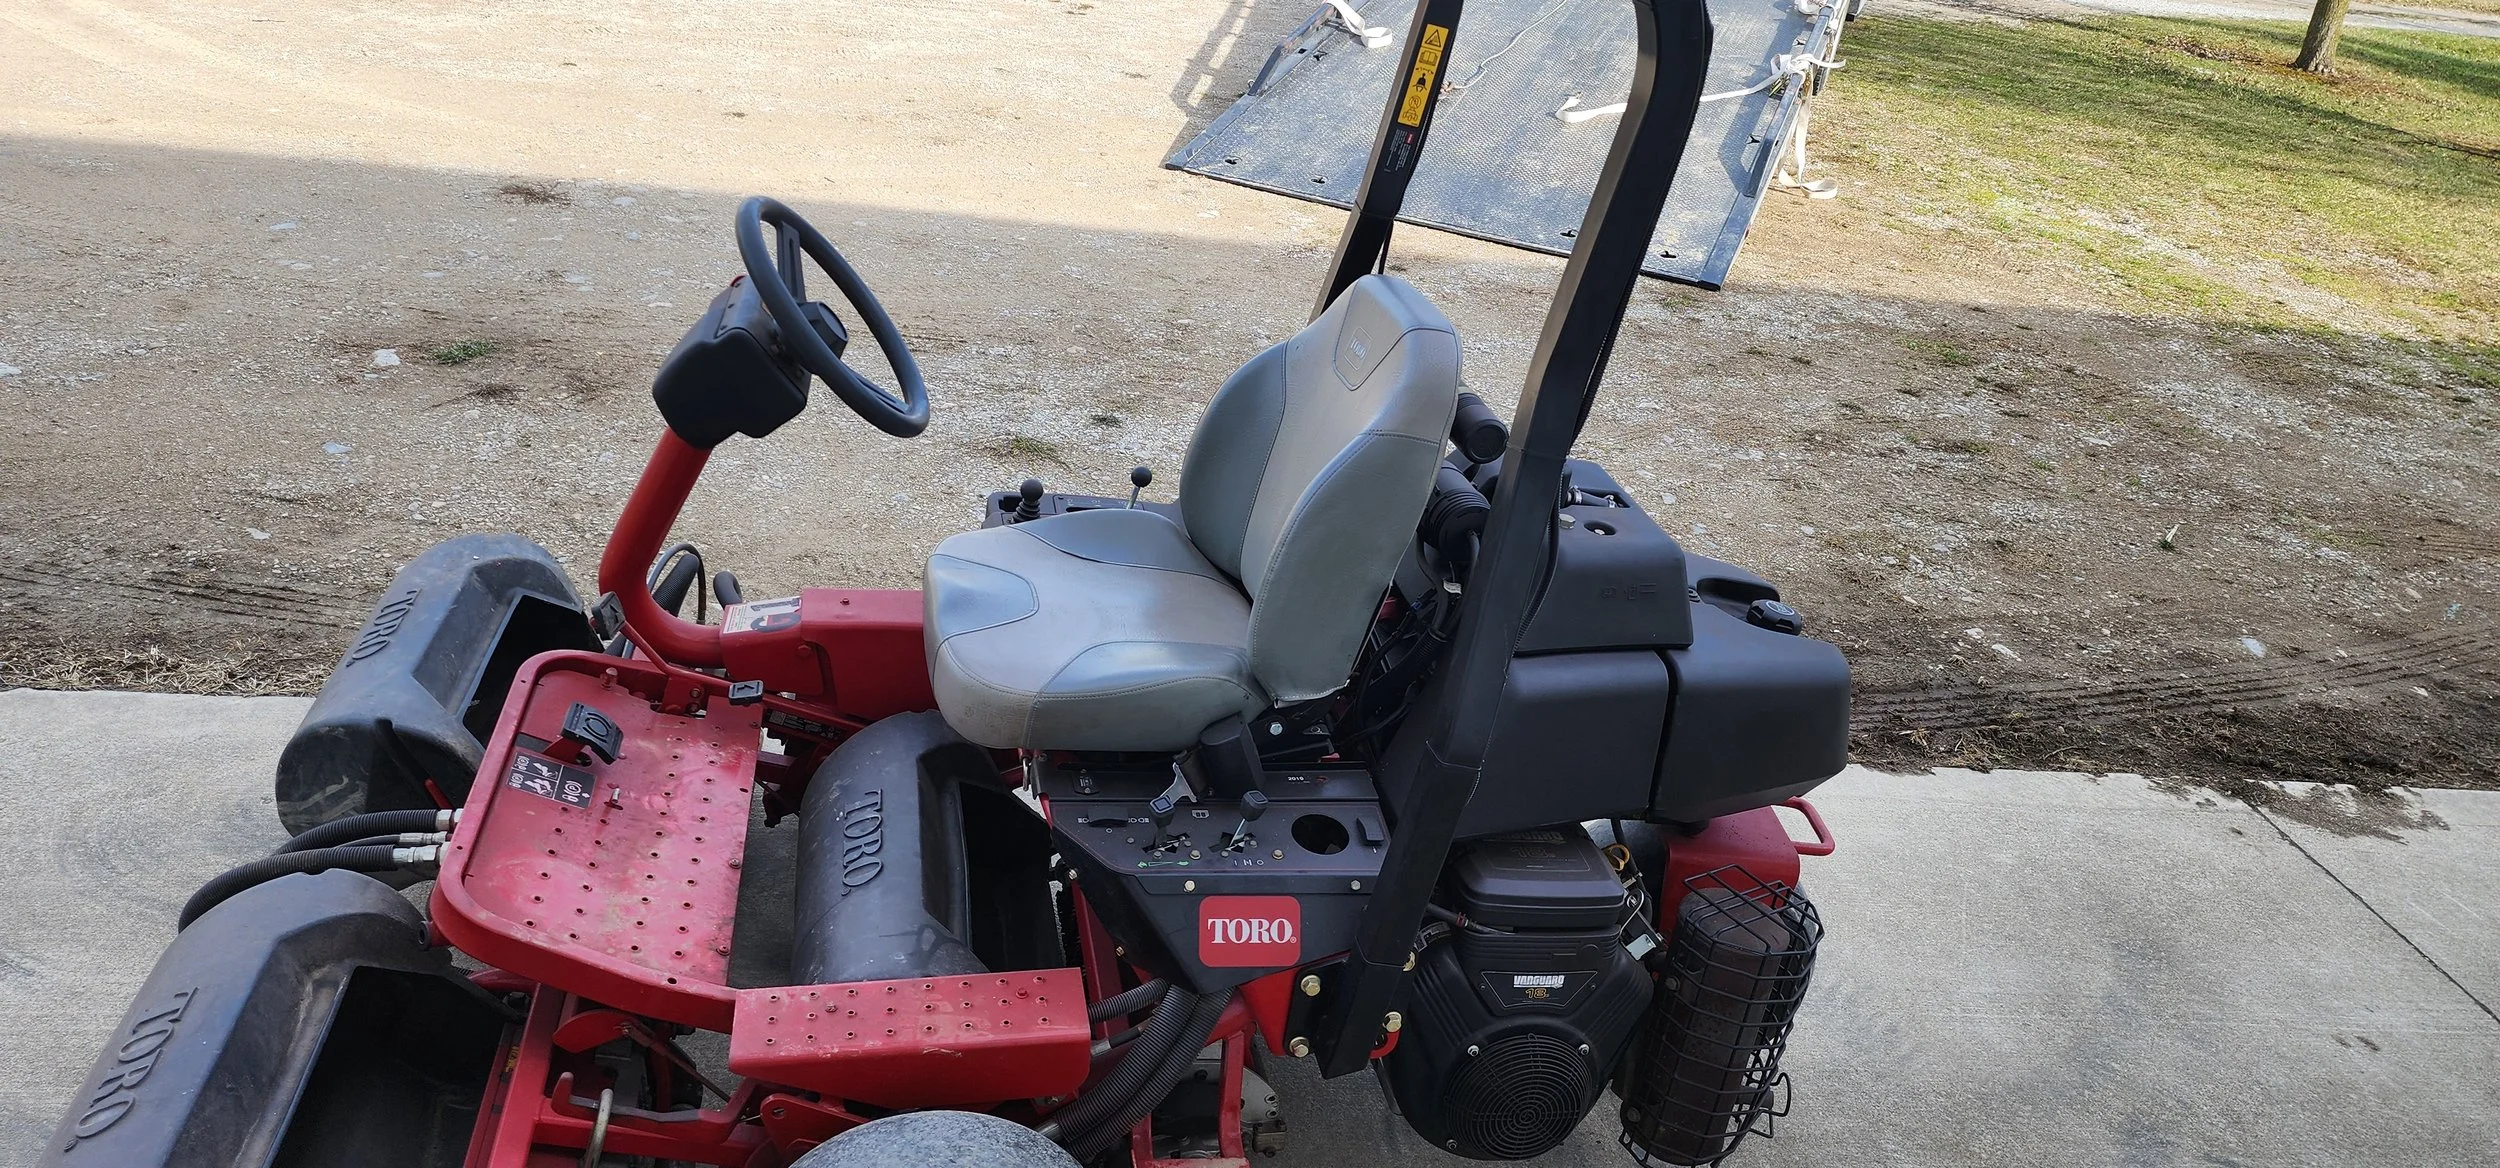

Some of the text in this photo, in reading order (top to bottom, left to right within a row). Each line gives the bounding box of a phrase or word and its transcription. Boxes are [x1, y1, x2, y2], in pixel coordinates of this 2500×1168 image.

[347, 588, 422, 666] TORO
[841, 788, 883, 894] TORO
[1207, 918, 1296, 944] TORO
[1513, 975, 1565, 986] VANGUARD
[1525, 987, 1546, 998] 18
[66, 986, 199, 1152] TORO
